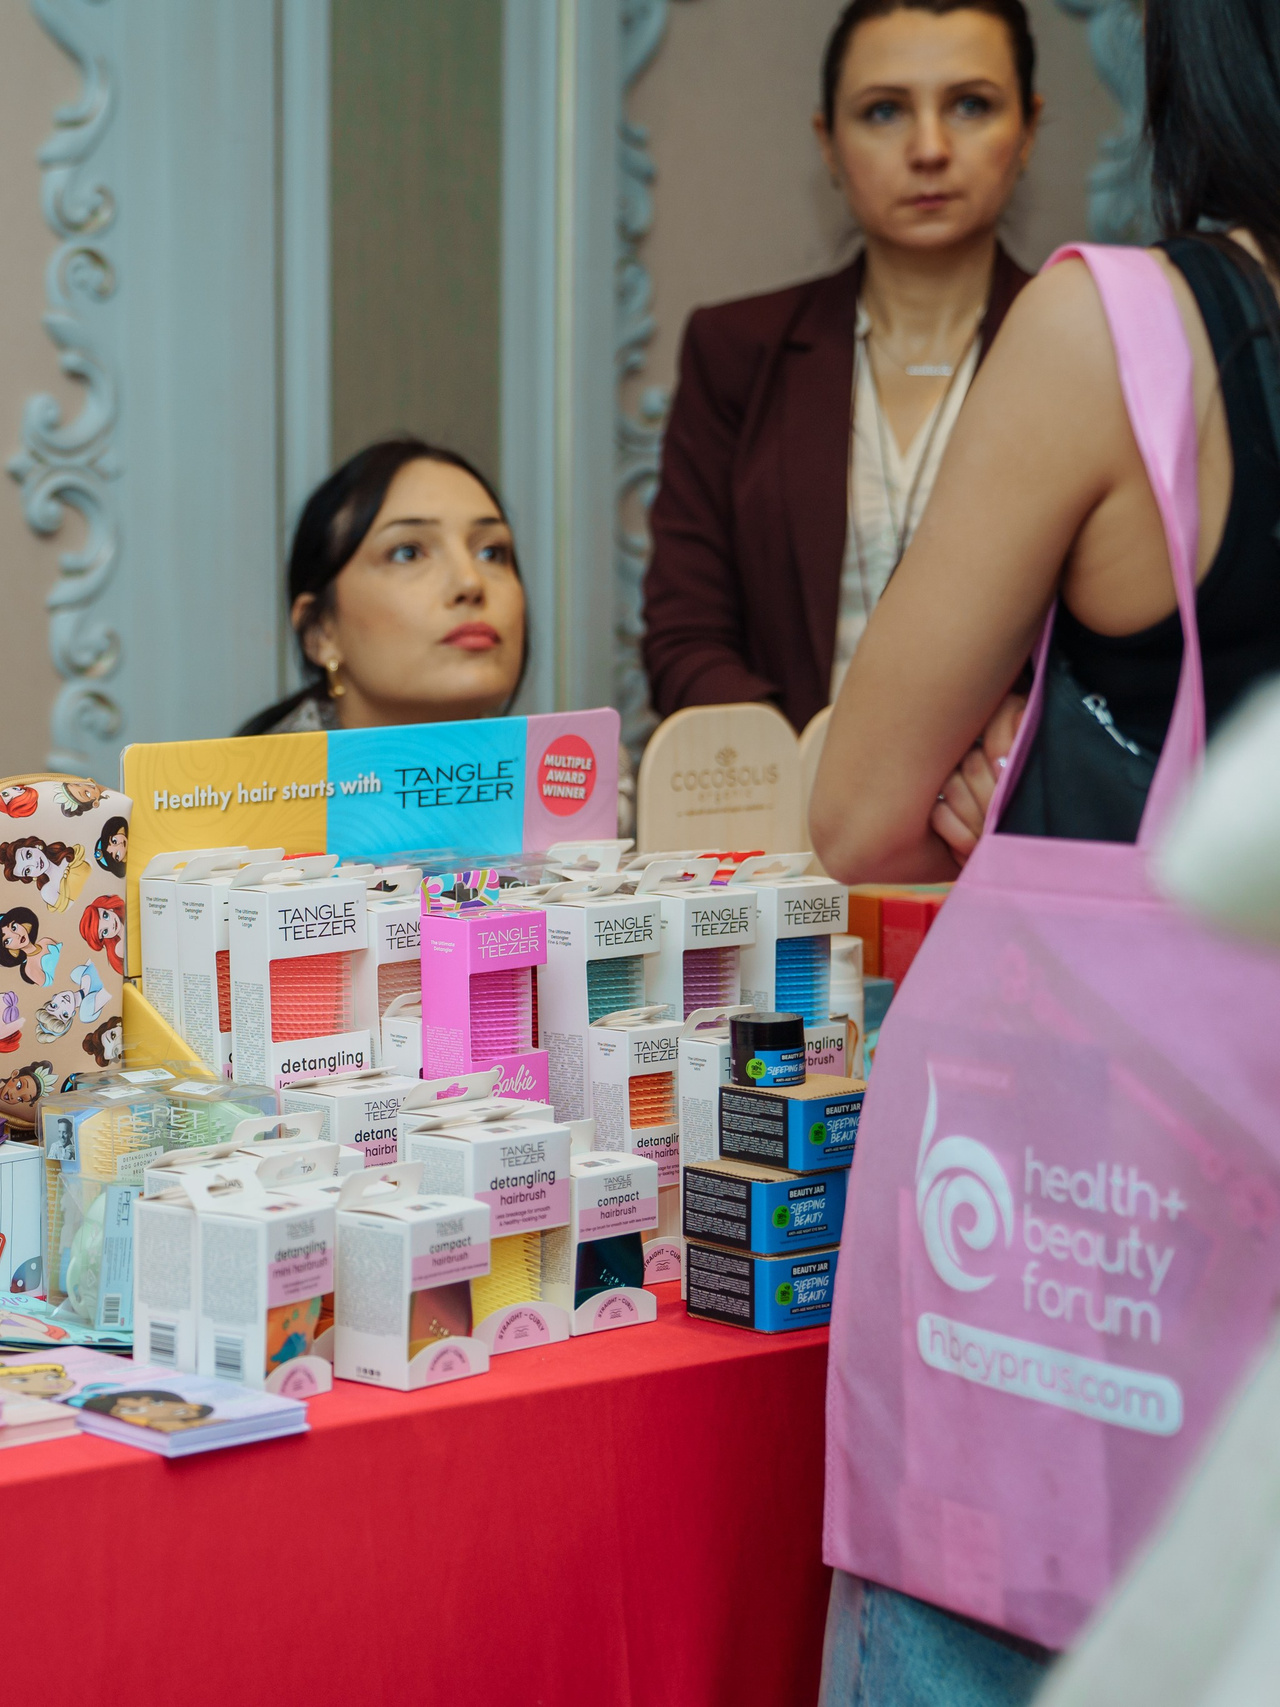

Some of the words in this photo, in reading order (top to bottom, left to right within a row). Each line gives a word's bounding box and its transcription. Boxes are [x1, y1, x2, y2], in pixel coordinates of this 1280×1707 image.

[544, 754, 593, 770] MULTIPLE
[394, 760, 514, 787] TANGLE
[546, 769, 586, 785] AWARD
[153, 784, 232, 811] Healthy
[237, 781, 277, 804] hair
[282, 779, 335, 800] starts
[339, 772, 382, 795] with
[394, 783, 514, 809] TEEZER
[542, 784, 586, 800] WINNER
[784, 896, 840, 912] TANGLE
[278, 901, 355, 924] TANGLE
[692, 907, 748, 923] TANGLE
[784, 910, 840, 925] TEEZER
[278, 919, 356, 941] TEEZER
[594, 915, 652, 933] TANGLE
[691, 921, 748, 936] TEEZER
[478, 925, 538, 945] TANGLE
[594, 929, 653, 947] TEEZER
[478, 940, 539, 959] TEEZER
[805, 1037, 844, 1053] ngling
[281, 1051, 364, 1074] detangling
[782, 1053, 799, 1061] BEAUTY
[805, 1054, 835, 1066] rbrush
[767, 1063, 798, 1076] SLEEPING
[490, 1064, 537, 1099] Barbie
[365, 1098, 401, 1112] TANGL
[826, 1104, 849, 1115] BEAUTY
[850, 1103, 861, 1112] JAR
[365, 1108, 397, 1121] TEEZ
[826, 1116, 860, 1133] SLEEPING
[354, 1127, 397, 1143] detang
[830, 1130, 858, 1143] BEAUTY
[365, 1144, 397, 1157] hairbr
[500, 1141, 545, 1157] TANGLE
[133, 1159, 156, 1168] GROOMI
[500, 1152, 545, 1167] TEEZER
[490, 1168, 555, 1190] detangling
[604, 1174, 632, 1184] TANGLE
[604, 1181, 632, 1191] TEEZER
[1023, 1146, 1187, 1222] health+
[500, 1189, 546, 1206] hairbrush
[597, 1191, 639, 1207] compact
[789, 1187, 813, 1198] BEAUTY
[814, 1185, 824, 1194] JAR
[600, 1206, 636, 1219] hairbrush
[790, 1198, 826, 1215] SLEEPING
[793, 1211, 823, 1227] BEAUTY
[274, 1240, 327, 1262] detangling
[429, 1237, 471, 1254] compact
[1023, 1203, 1175, 1296] beauty
[432, 1252, 468, 1266] hairbrush
[670, 1249, 681, 1264] CURL
[792, 1265, 816, 1276] BEAUTY
[817, 1262, 828, 1271] JAR
[793, 1275, 829, 1292] SLEEPING
[797, 1289, 826, 1304] BEAUTY
[1021, 1260, 1162, 1345] forum
[498, 1312, 522, 1340] STRAIGHT
[528, 1312, 545, 1332] CURLY
[928, 1318, 1166, 1424] hbcyprus.com
